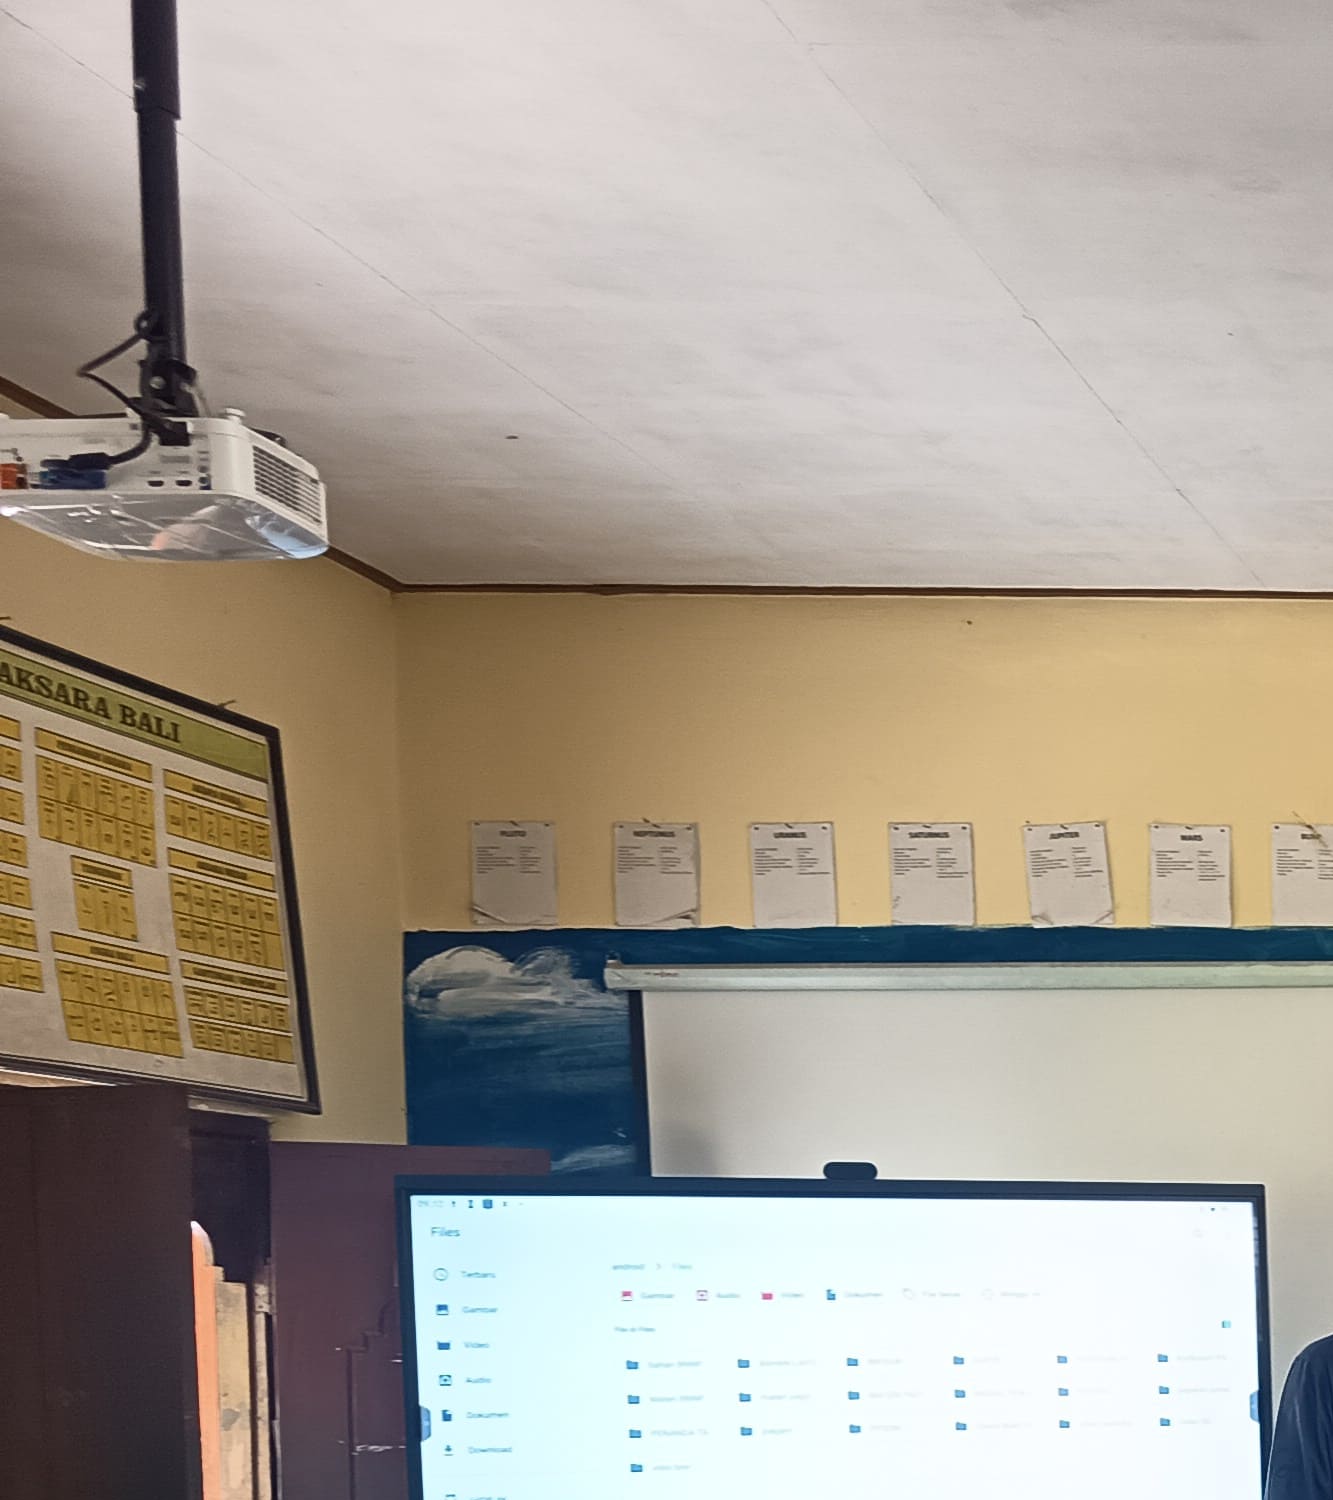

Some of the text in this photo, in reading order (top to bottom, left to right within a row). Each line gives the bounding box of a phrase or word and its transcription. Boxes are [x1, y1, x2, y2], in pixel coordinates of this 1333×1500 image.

[0, 662, 181, 743] AKSARA BALI
[430, 1226, 461, 1237] Files
